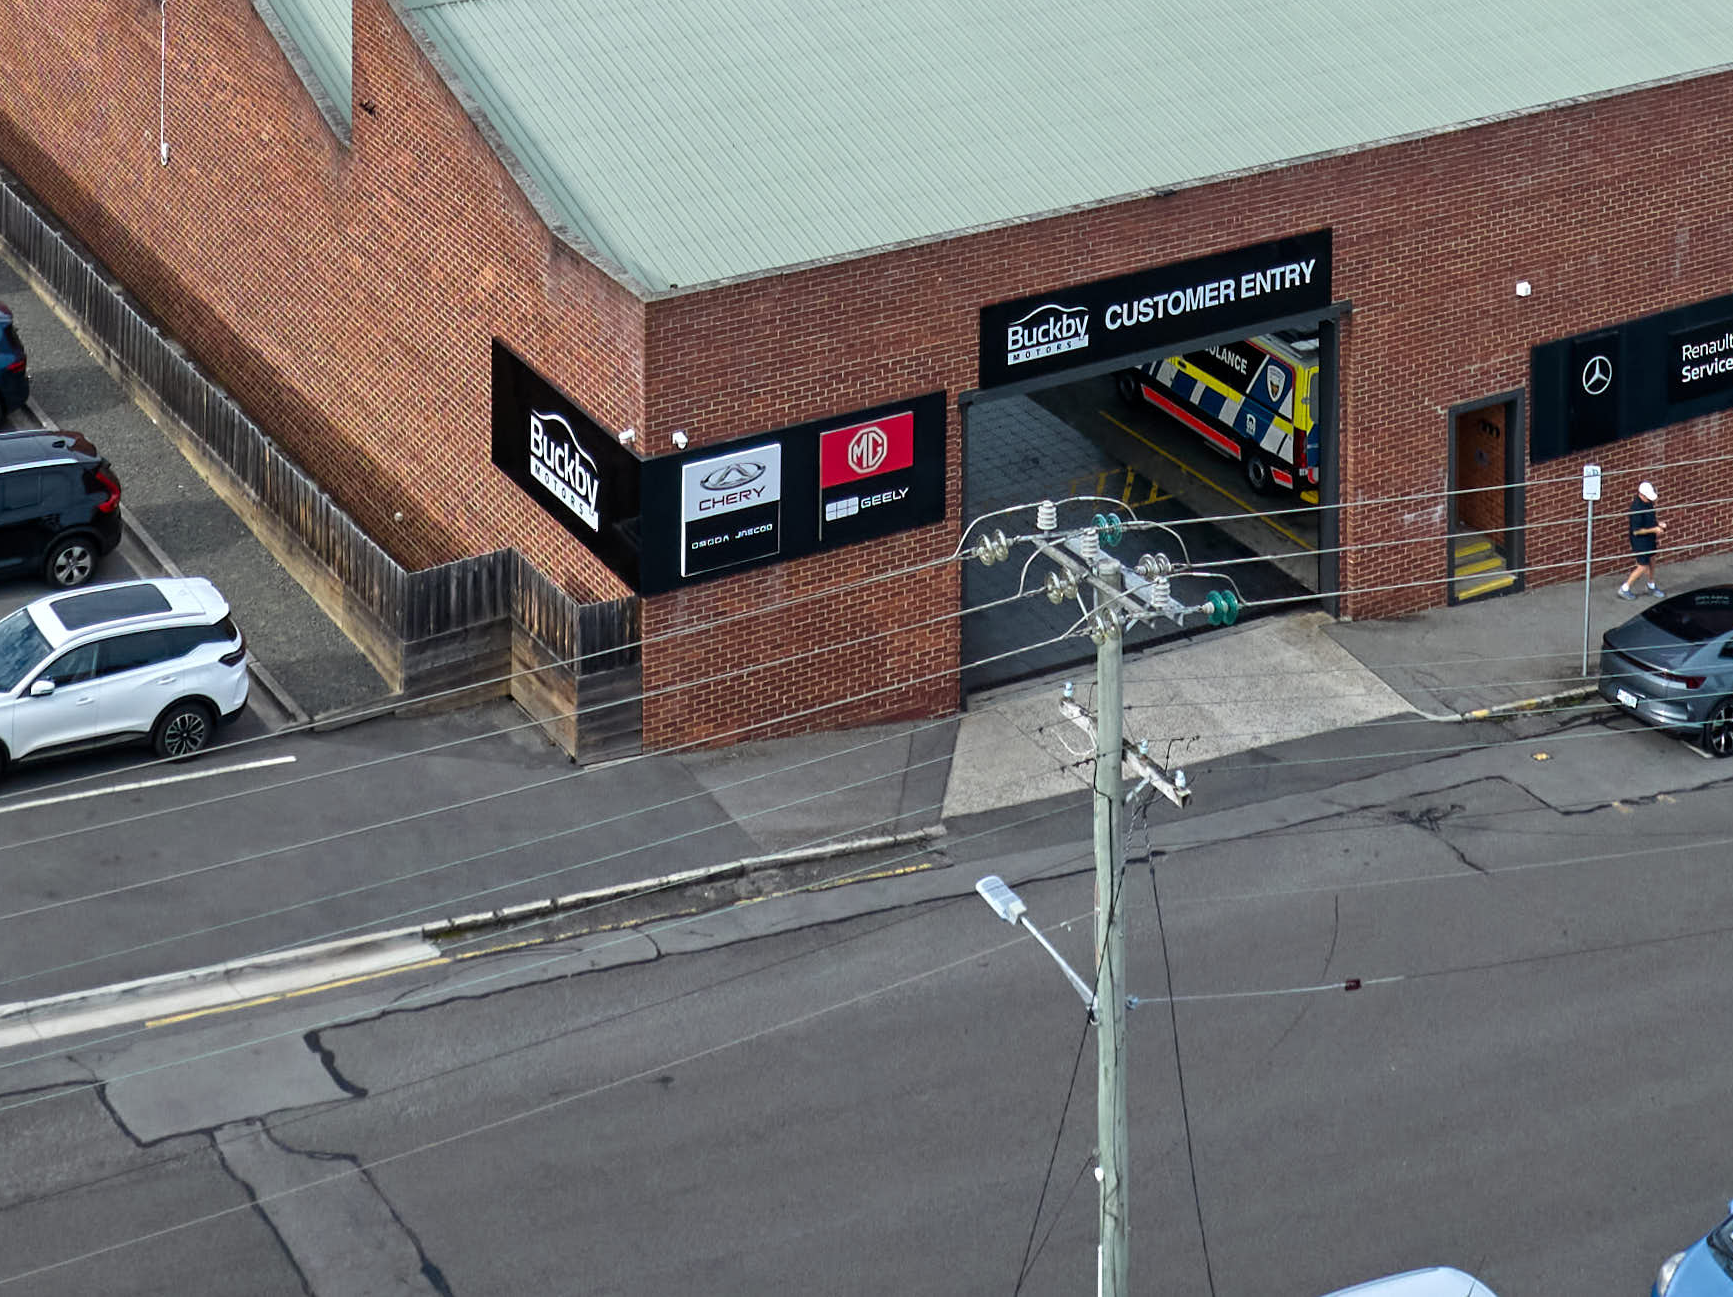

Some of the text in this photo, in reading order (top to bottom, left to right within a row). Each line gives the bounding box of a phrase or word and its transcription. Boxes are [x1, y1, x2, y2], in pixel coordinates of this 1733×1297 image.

[1105, 259, 1316, 331] CUSTOMER ENTRY
[1007, 314, 1089, 351] Buckby
[1012, 340, 1072, 362] MOTORS
[530, 414, 599, 516] Buckby
[852, 432, 883, 469] MG
[534, 463, 585, 517] MOTORS
[698, 485, 767, 512] CHERY
[860, 487, 910, 509] GEELY
